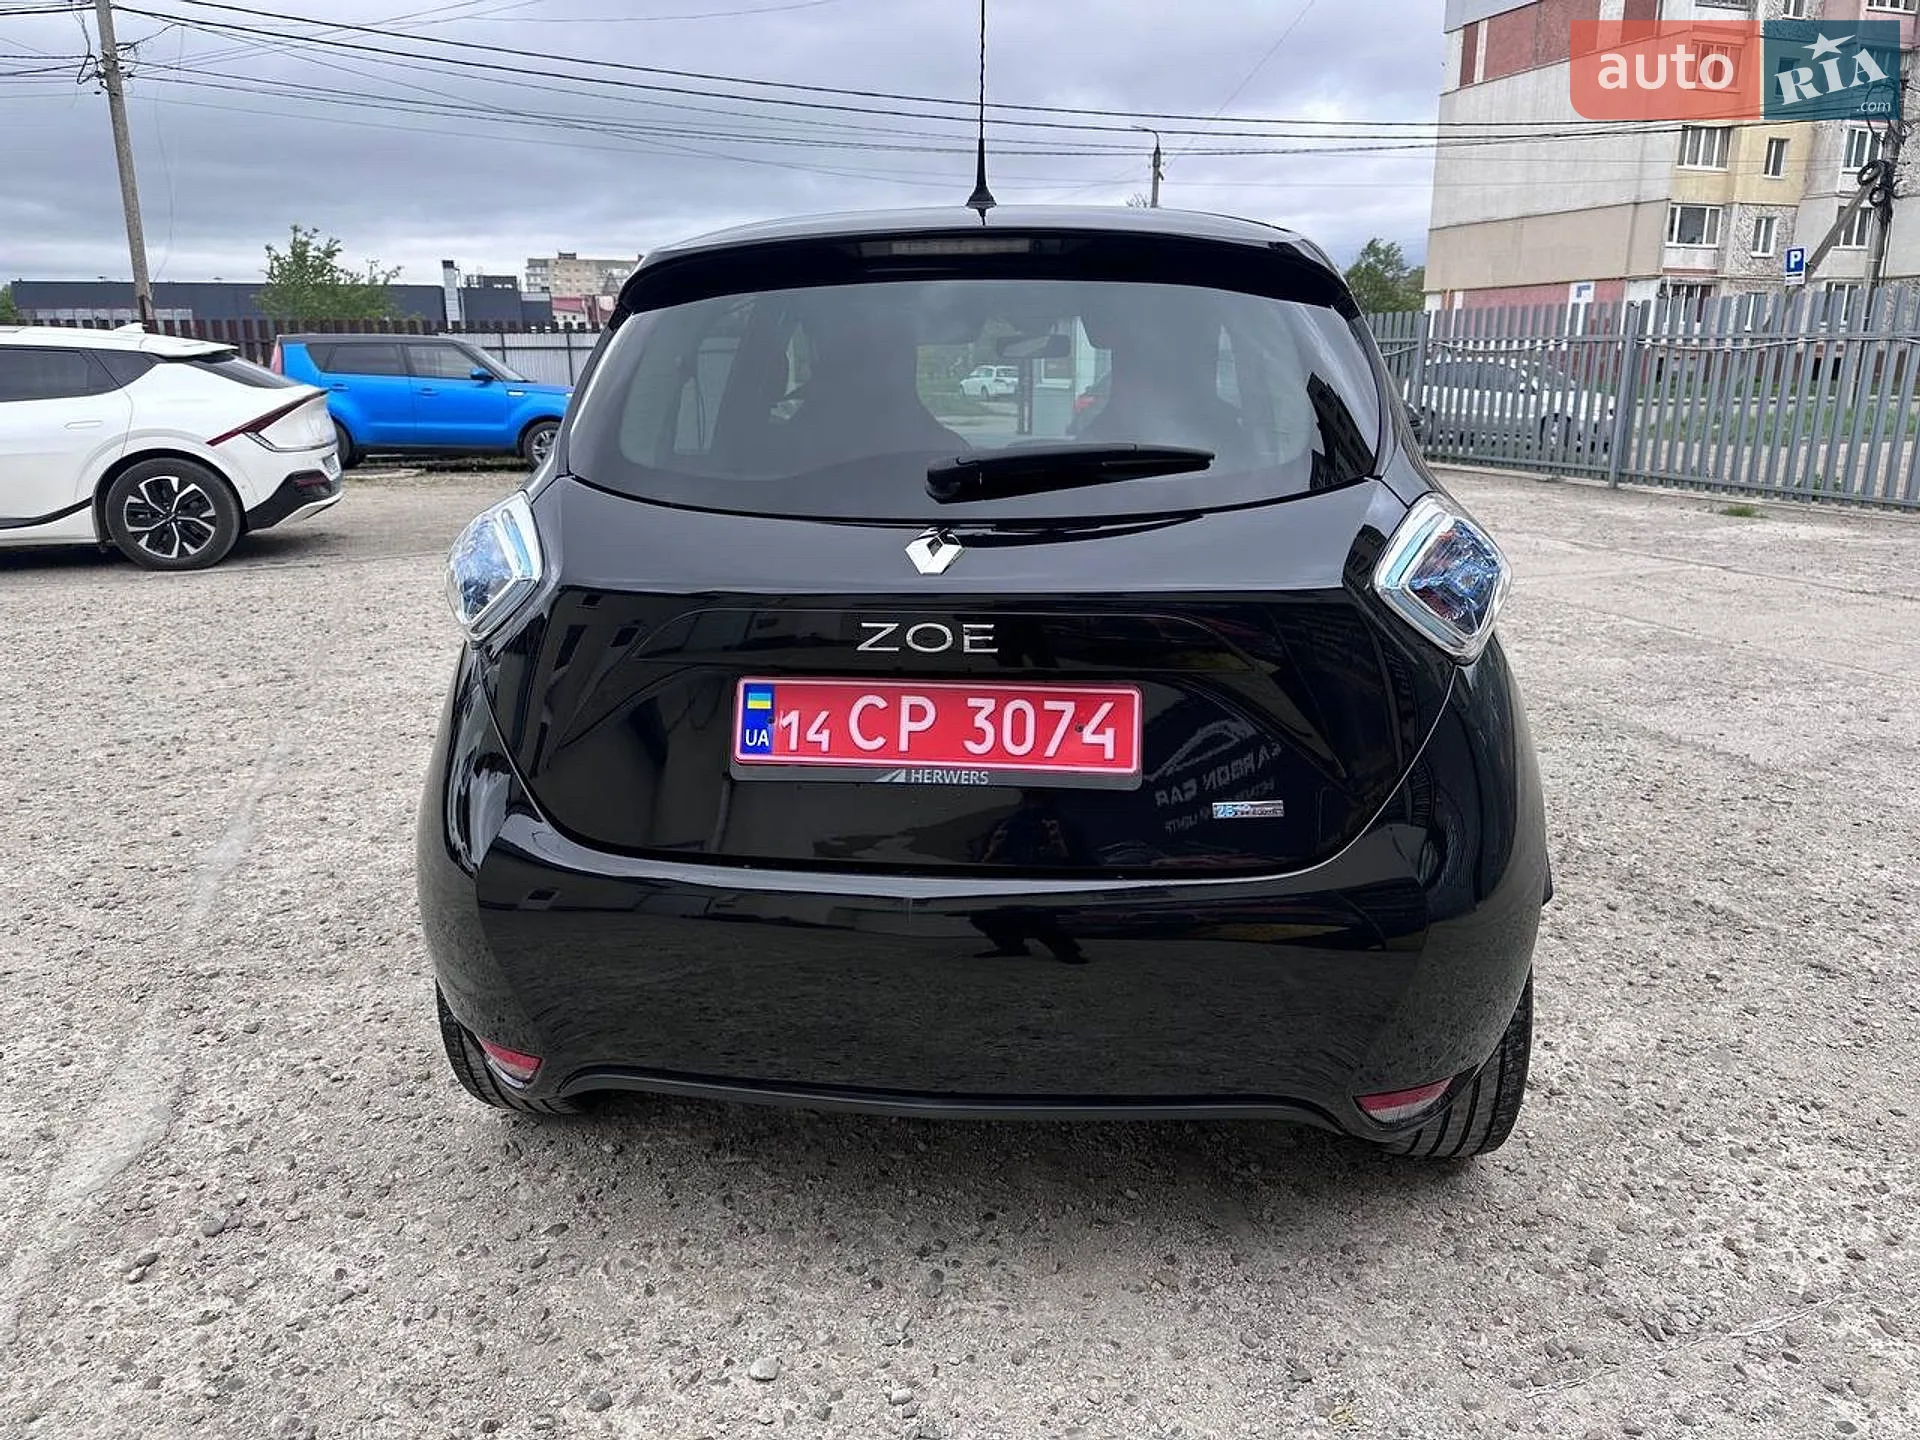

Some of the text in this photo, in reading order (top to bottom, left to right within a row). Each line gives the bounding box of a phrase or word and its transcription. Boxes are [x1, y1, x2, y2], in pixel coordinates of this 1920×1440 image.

[1790, 250, 1802, 269] P
[855, 622, 999, 653] ZOE
[780, 693, 1116, 761] 14 CP 3074
[745, 728, 770, 747] UA
[910, 768, 989, 786] HERWERS
